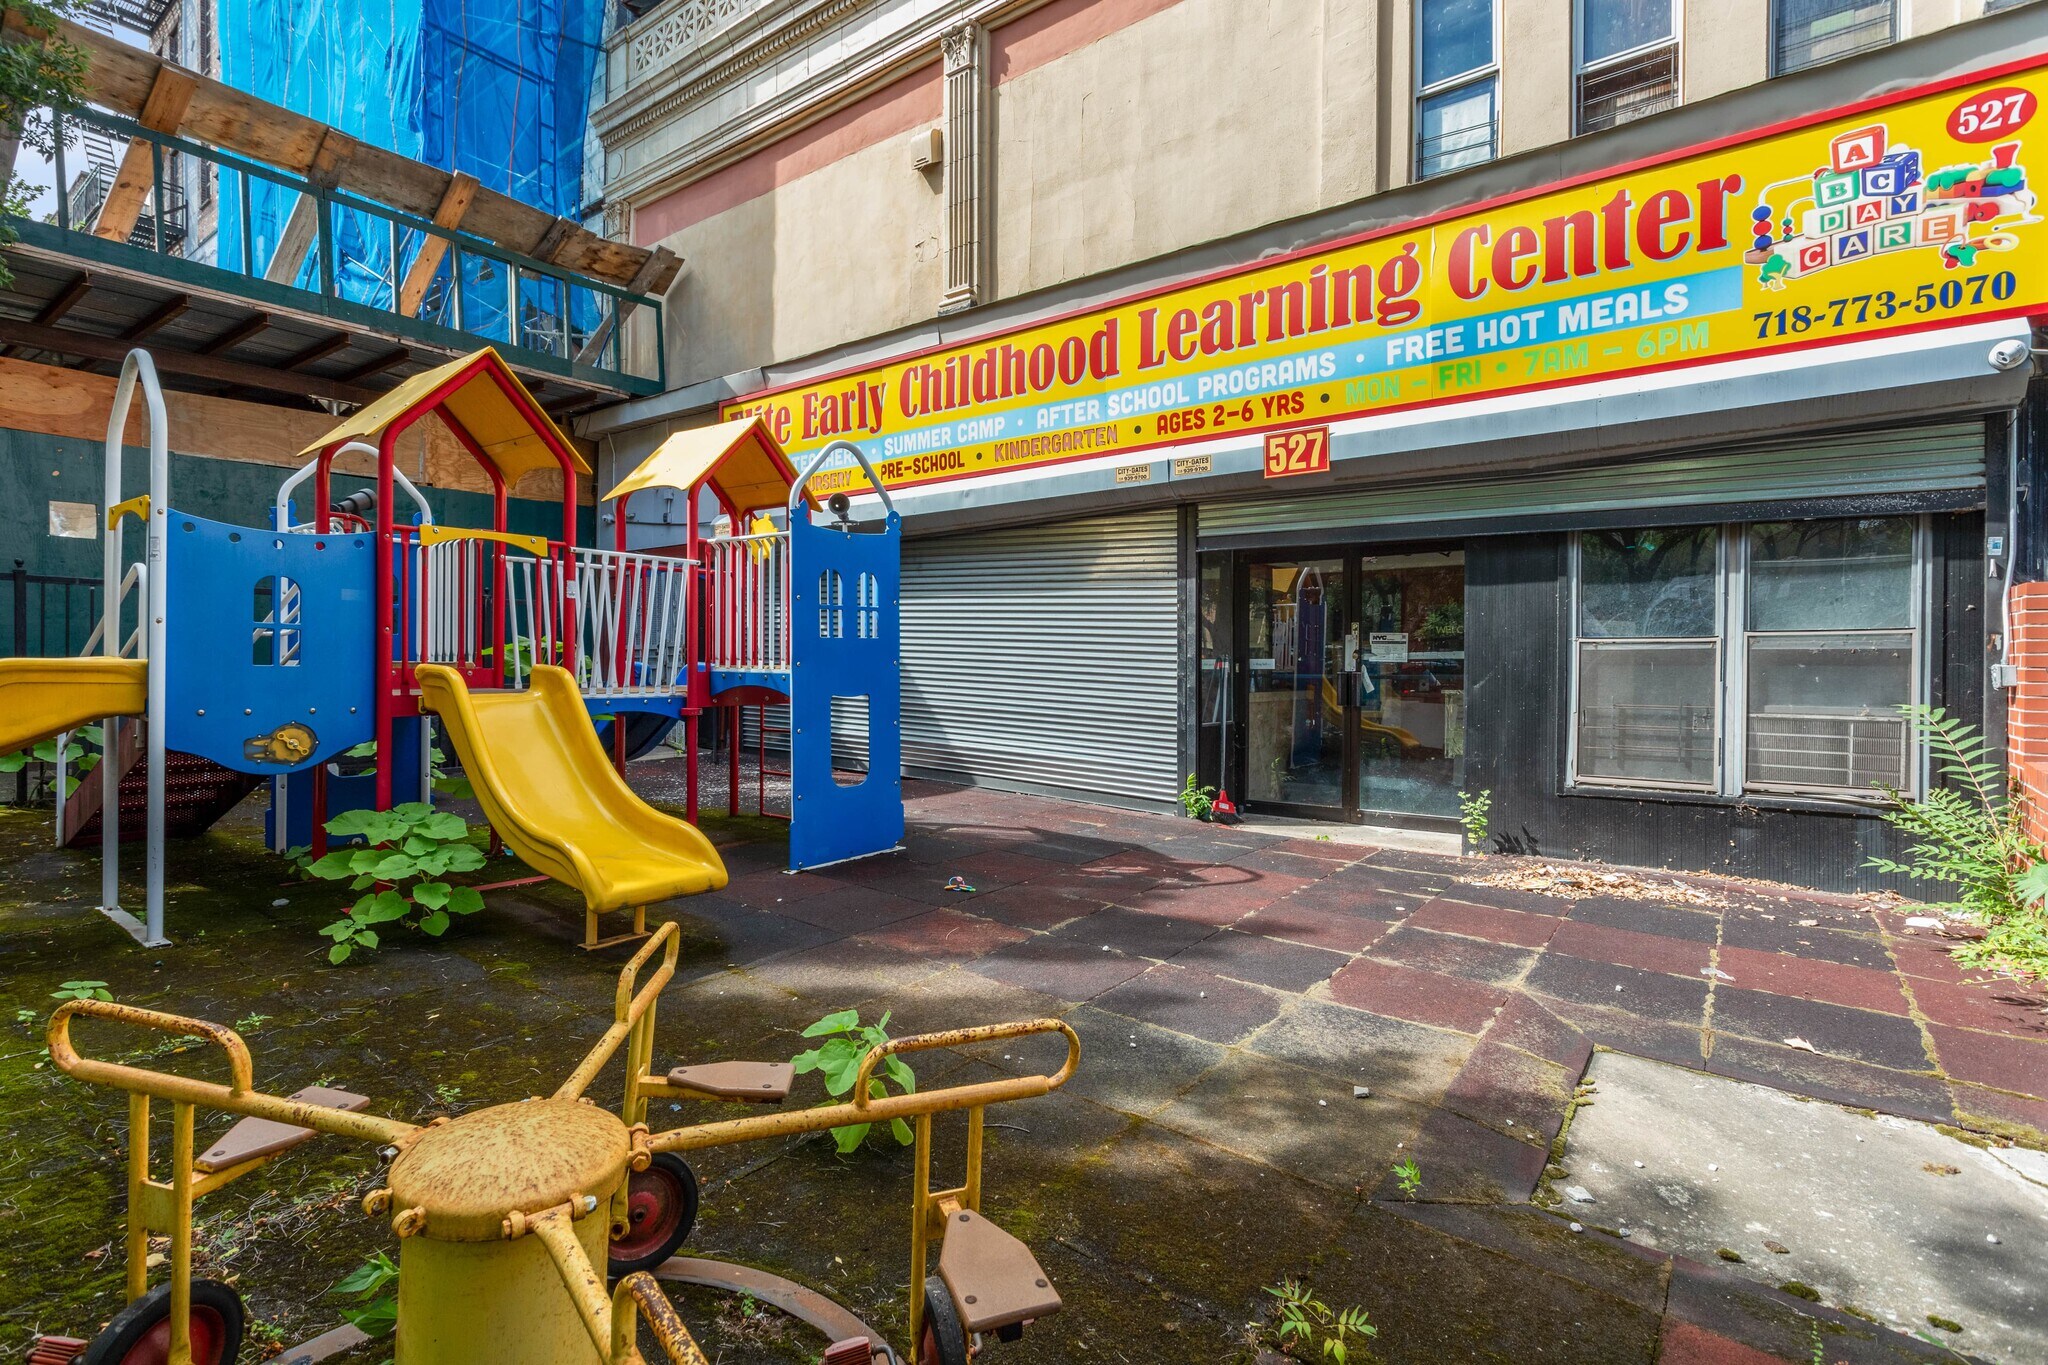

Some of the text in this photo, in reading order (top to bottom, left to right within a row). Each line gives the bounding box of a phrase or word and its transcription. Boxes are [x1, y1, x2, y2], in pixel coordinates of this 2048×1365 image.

[1957, 92, 2028, 135] 527
[1823, 194, 1914, 232] DAY
[1803, 215, 1949, 268] CARE
[801, 173, 1742, 440] Early Childhood Learning Center
[1753, 271, 2017, 340] 718-773-5070
[884, 427, 952, 457] SUMMER
[957, 416, 1006, 443] CAMP
[1036, 399, 1100, 429] AFTER
[1107, 381, 1190, 417] SCHOOL
[1198, 351, 1336, 399] PROGRAMS
[1387, 325, 1464, 366] FREE
[1477, 310, 1545, 348] HOT
[1558, 283, 1689, 335] MEALS
[806, 470, 852, 492] URSERY
[881, 450, 965, 481] PRE-SCHOOL
[994, 424, 1119, 463] KINDERGARTEN
[1156, 407, 1206, 436] AGES
[1212, 399, 1254, 426] 2-6
[1261, 391, 1305, 419] YRS
[1345, 375, 1401, 405] MON
[1438, 360, 1482, 391] FRI
[1523, 341, 1589, 377] 7AM
[1636, 320, 1710, 359] 6PM
[1117, 465, 1148, 475] CITY-GATES
[1176, 456, 1209, 468] CITY-GATES
[1269, 431, 1324, 473] 527
